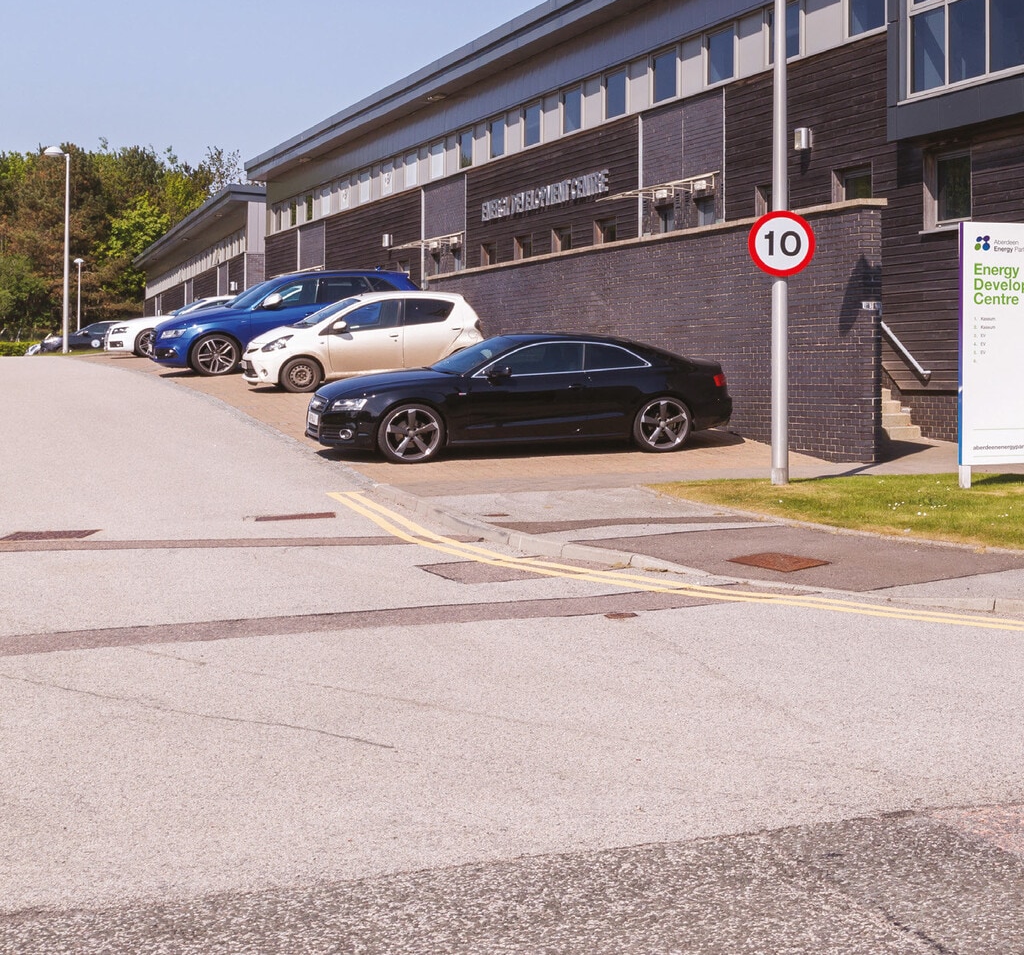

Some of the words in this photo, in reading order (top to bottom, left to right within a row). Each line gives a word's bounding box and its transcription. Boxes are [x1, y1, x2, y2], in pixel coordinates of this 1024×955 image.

[481, 196, 510, 222] ENERGY
[510, 179, 572, 215] DEVELOPMENT
[571, 169, 610, 200] CENTRE
[764, 230, 802, 257] 10
[973, 263, 1020, 279] Energy
[973, 292, 1020, 306] Centre
